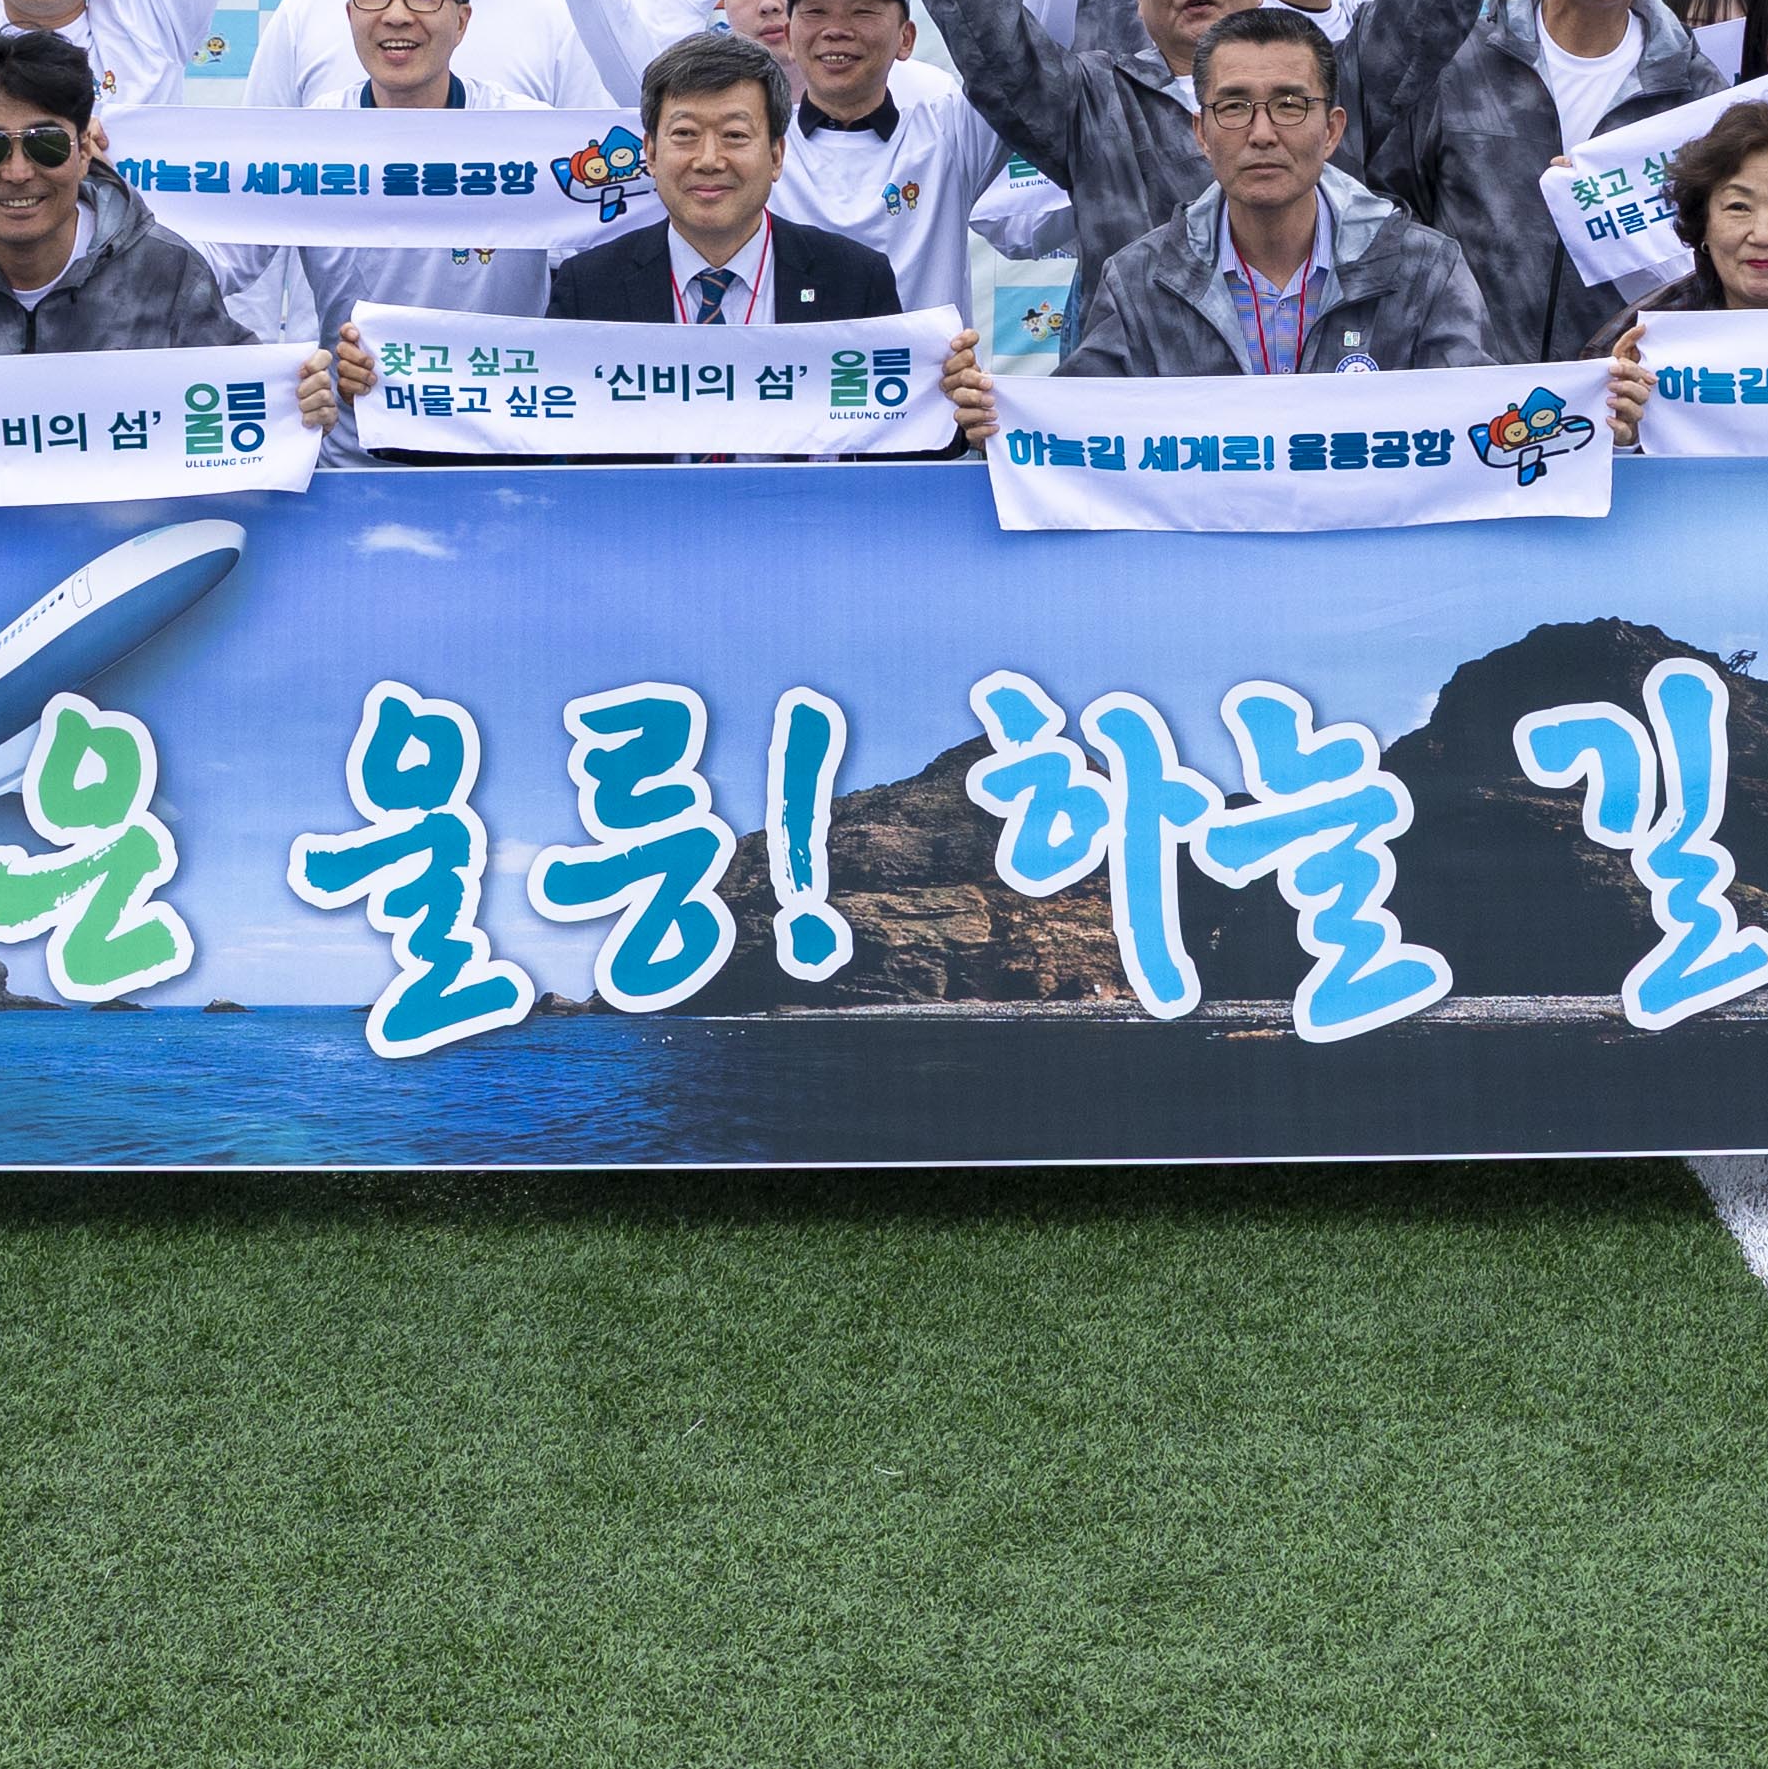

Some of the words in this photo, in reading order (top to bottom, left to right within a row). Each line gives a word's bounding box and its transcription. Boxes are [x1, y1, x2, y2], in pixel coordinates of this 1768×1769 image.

[241, 162, 371, 198] 세계로!
[382, 161, 540, 198] 울릉공항
[1009, 178, 1050, 189] ULLEUNG
[1570, 167, 1635, 212] 찾고
[1641, 151, 1681, 187] 싶
[1584, 193, 1678, 242] 머물고
[382, 343, 454, 378] 찾고
[469, 347, 540, 378] 싶고
[831, 348, 912, 409] 울릉
[185, 382, 268, 456] 울릉
[385, 384, 492, 418] 머물고
[506, 386, 578, 420] 싶은
[829, 410, 879, 420] ULLEUNG
[882, 411, 909, 421] CITY
[184, 459, 236, 469] ULLEUNG
[239, 456, 266, 466] CITY
[1006, 429, 1128, 473] 하늘길
[1138, 435, 1277, 474] 세계로!
[1288, 429, 1457, 473] 울릉공항
[293, 682, 851, 1056] 울릉!
